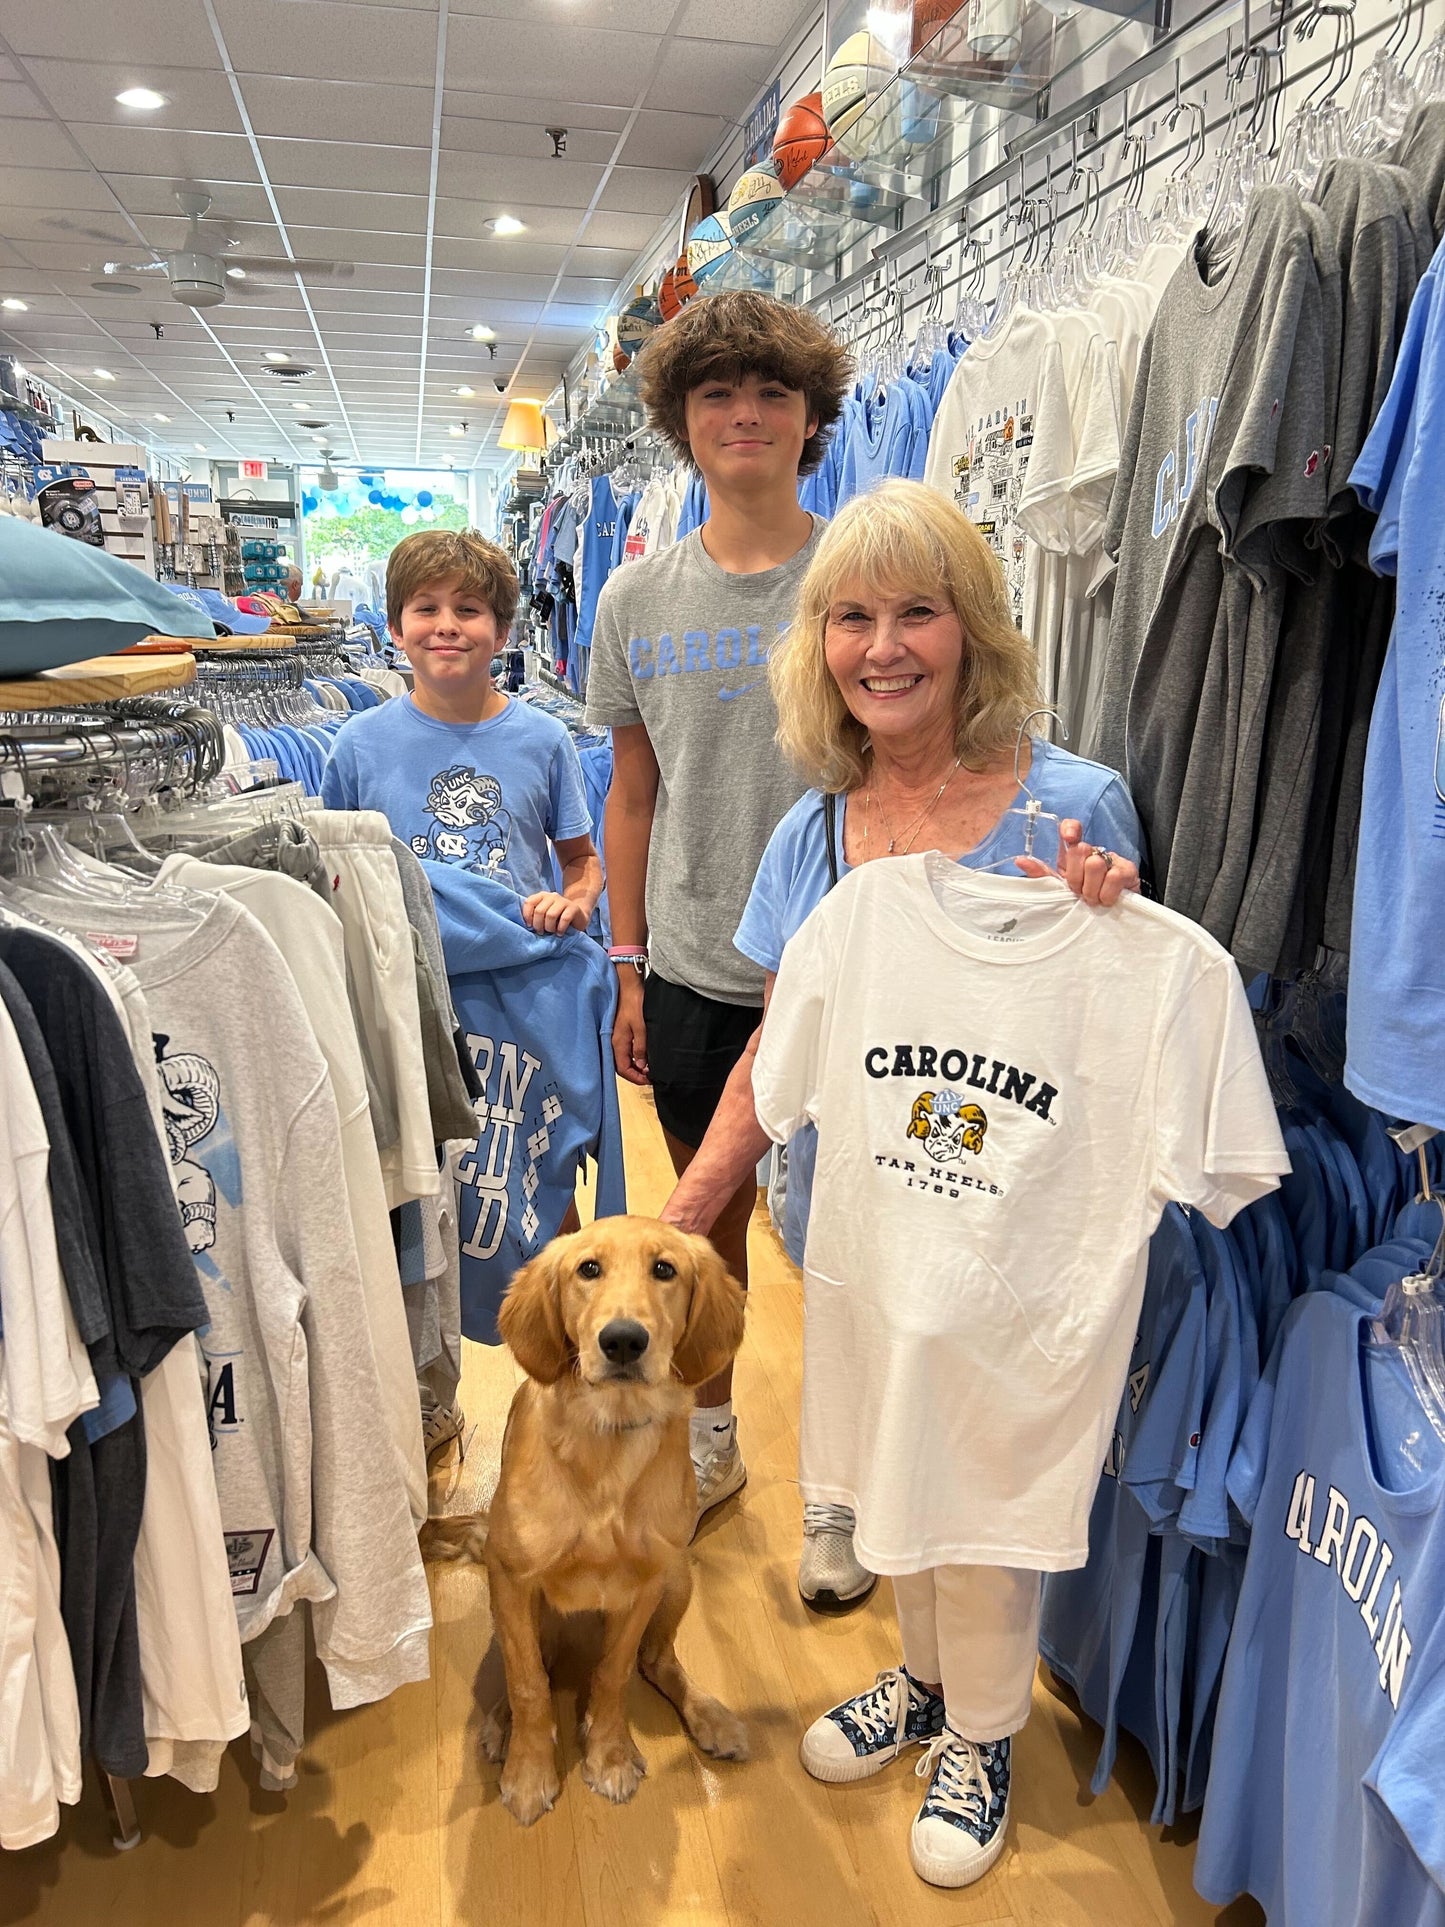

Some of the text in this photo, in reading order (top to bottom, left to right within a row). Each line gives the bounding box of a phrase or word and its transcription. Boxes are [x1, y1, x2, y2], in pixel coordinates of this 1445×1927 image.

[243, 461, 263, 478] EXIT
[183, 488, 208, 499] LUMNI
[629, 620, 792, 680] CAROL
[447, 772, 471, 789] UNC
[864, 1044, 1059, 1121] CAROLINA
[933, 1102, 959, 1114] UNC
[875, 1155, 1003, 1195] TAR HEELS
[906, 1177, 960, 1199] 1789
